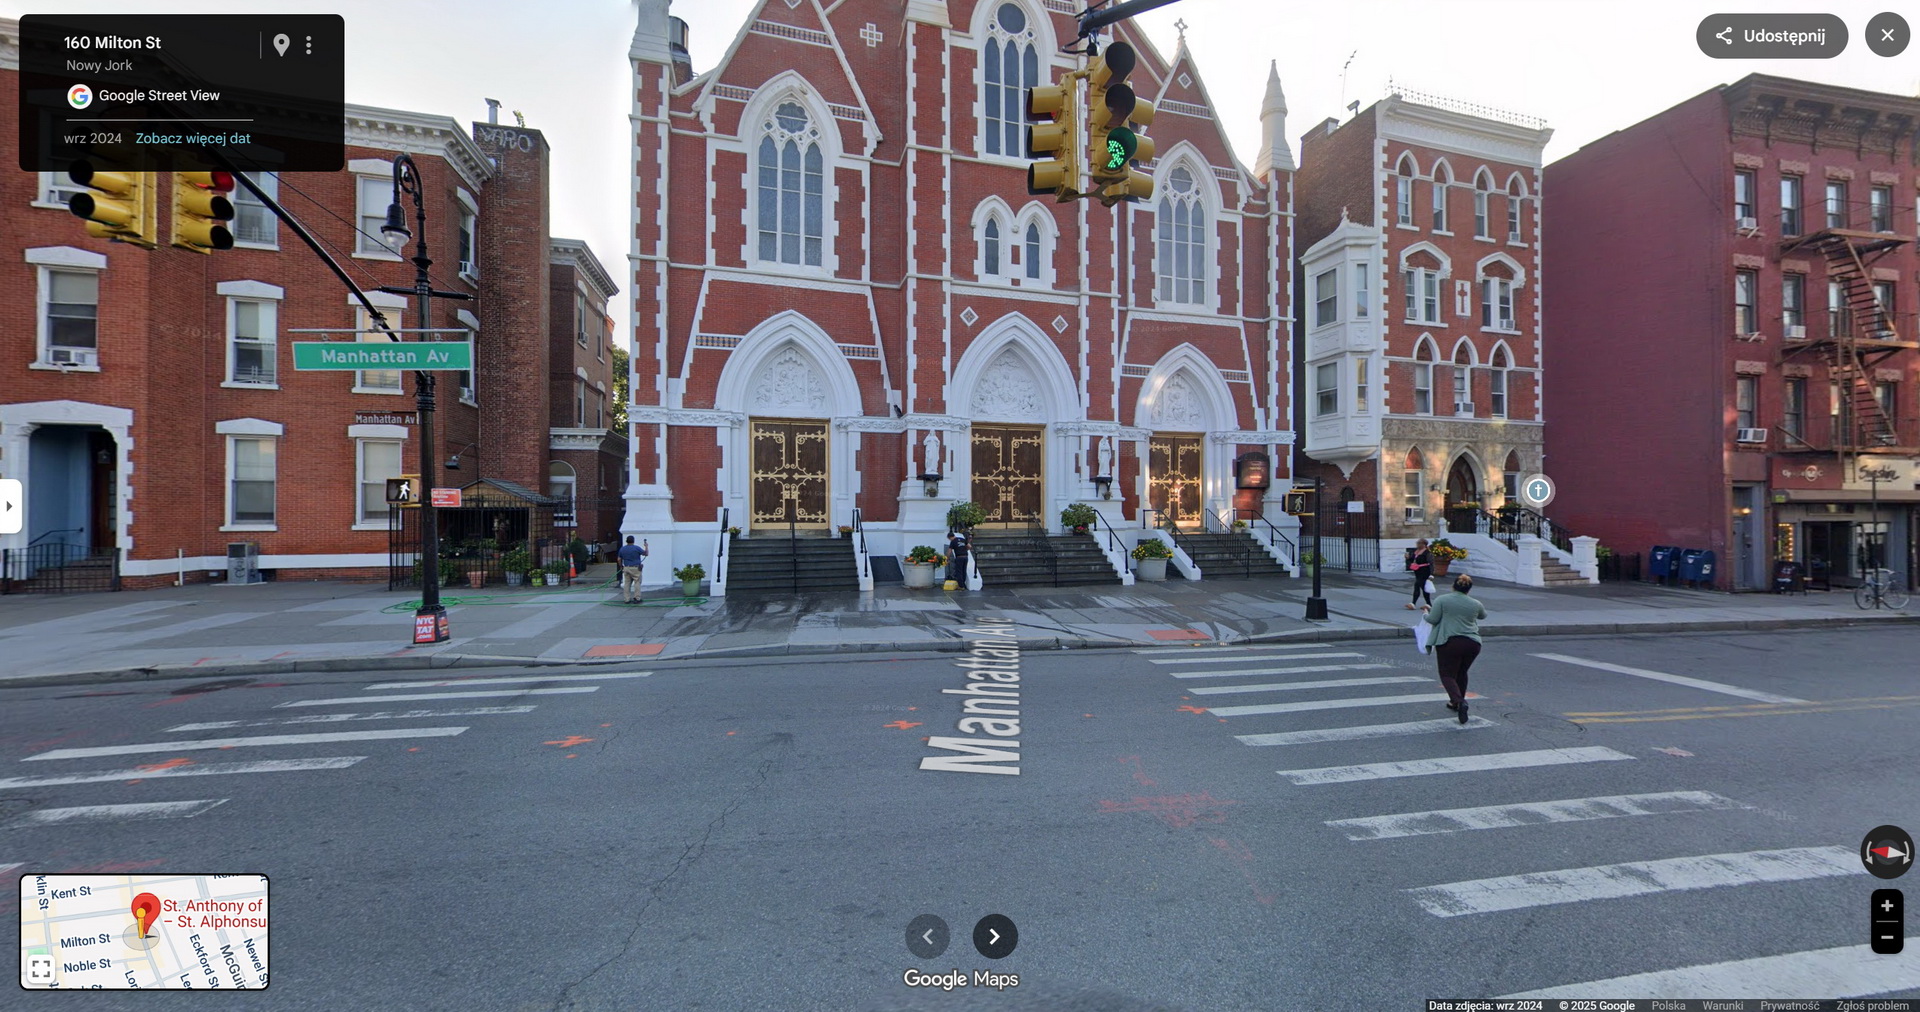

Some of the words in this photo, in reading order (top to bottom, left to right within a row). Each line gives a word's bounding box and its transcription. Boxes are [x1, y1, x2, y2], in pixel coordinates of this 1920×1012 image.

[322, 349, 417, 363] Manhattan
[427, 349, 449, 363] Av
[355, 414, 402, 424] Manhattan
[404, 415, 415, 424] Av
[416, 617, 435, 625] NYC
[417, 626, 434, 634] TAT
